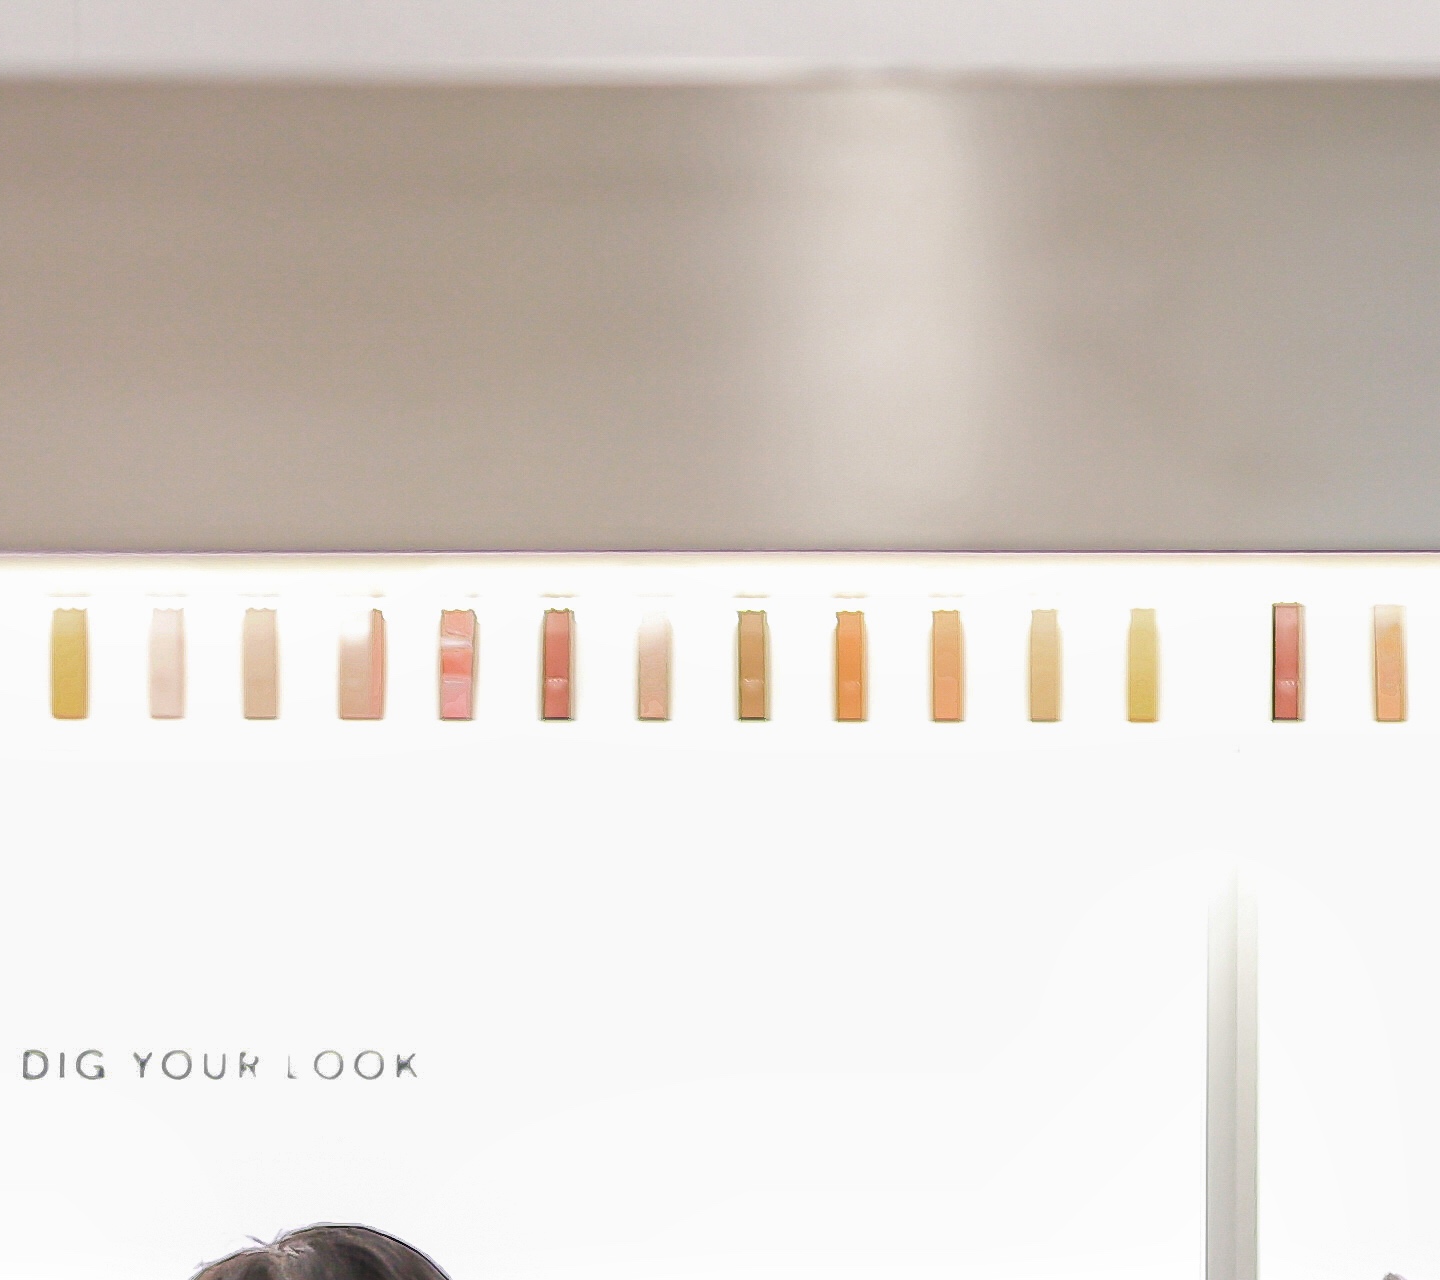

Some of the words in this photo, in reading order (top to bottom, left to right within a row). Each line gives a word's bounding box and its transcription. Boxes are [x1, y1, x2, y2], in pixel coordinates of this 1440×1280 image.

[21, 1047, 106, 1082] DIG
[132, 1047, 260, 1082] YOUR
[285, 1047, 418, 1082] LOOK
